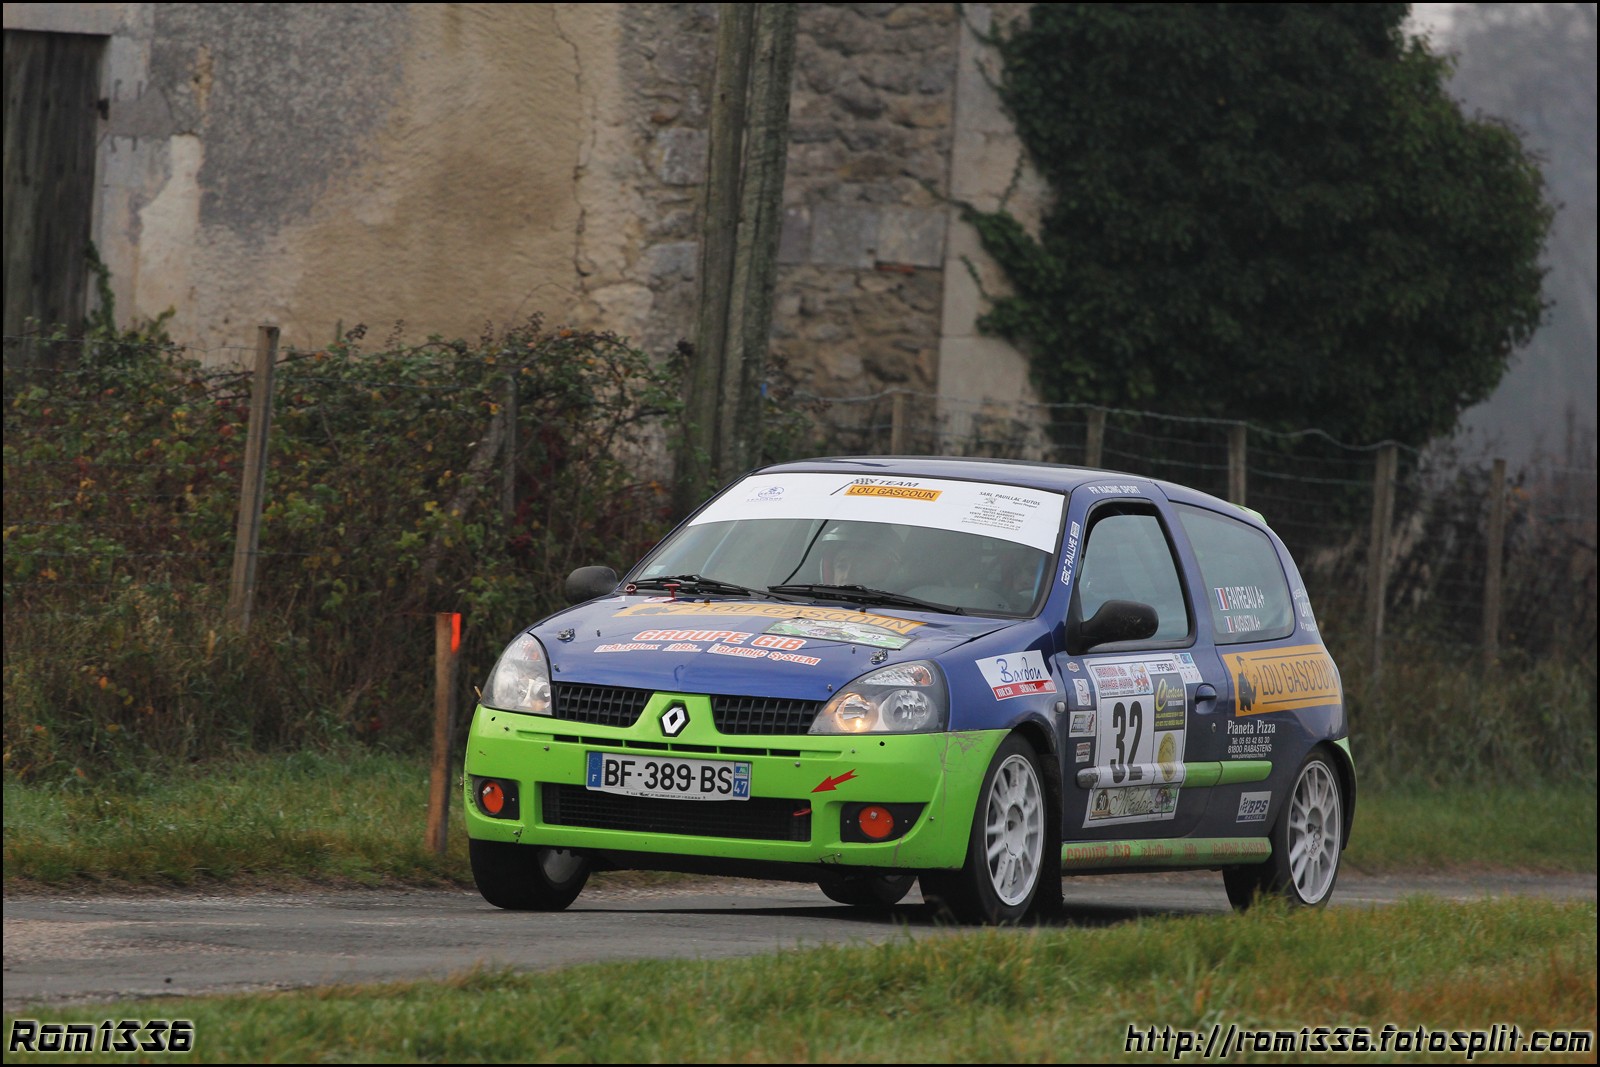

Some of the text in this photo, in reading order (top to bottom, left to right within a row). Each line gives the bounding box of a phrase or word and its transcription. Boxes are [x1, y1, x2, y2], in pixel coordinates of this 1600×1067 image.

[880, 479, 919, 487] TEAM
[1119, 485, 1141, 494] SPORT
[849, 486, 937, 499] LOU GASCOUN
[1022, 498, 1041, 506] AUTOS
[1065, 536, 1078, 568] RALLYE
[694, 604, 757, 613] LOU
[762, 607, 913, 630] GASCOUN
[633, 630, 753, 645] GROUPE
[1156, 663, 1175, 672] FFSA
[1256, 664, 1283, 696] LOU
[1227, 719, 1276, 735] Pianeta Pizza
[1109, 701, 1144, 784] 32
[1243, 744, 1272, 753] RABASTENS
[591, 774, 597, 782] F
[734, 780, 748, 795] 47
[1247, 800, 1268, 814] BPS
